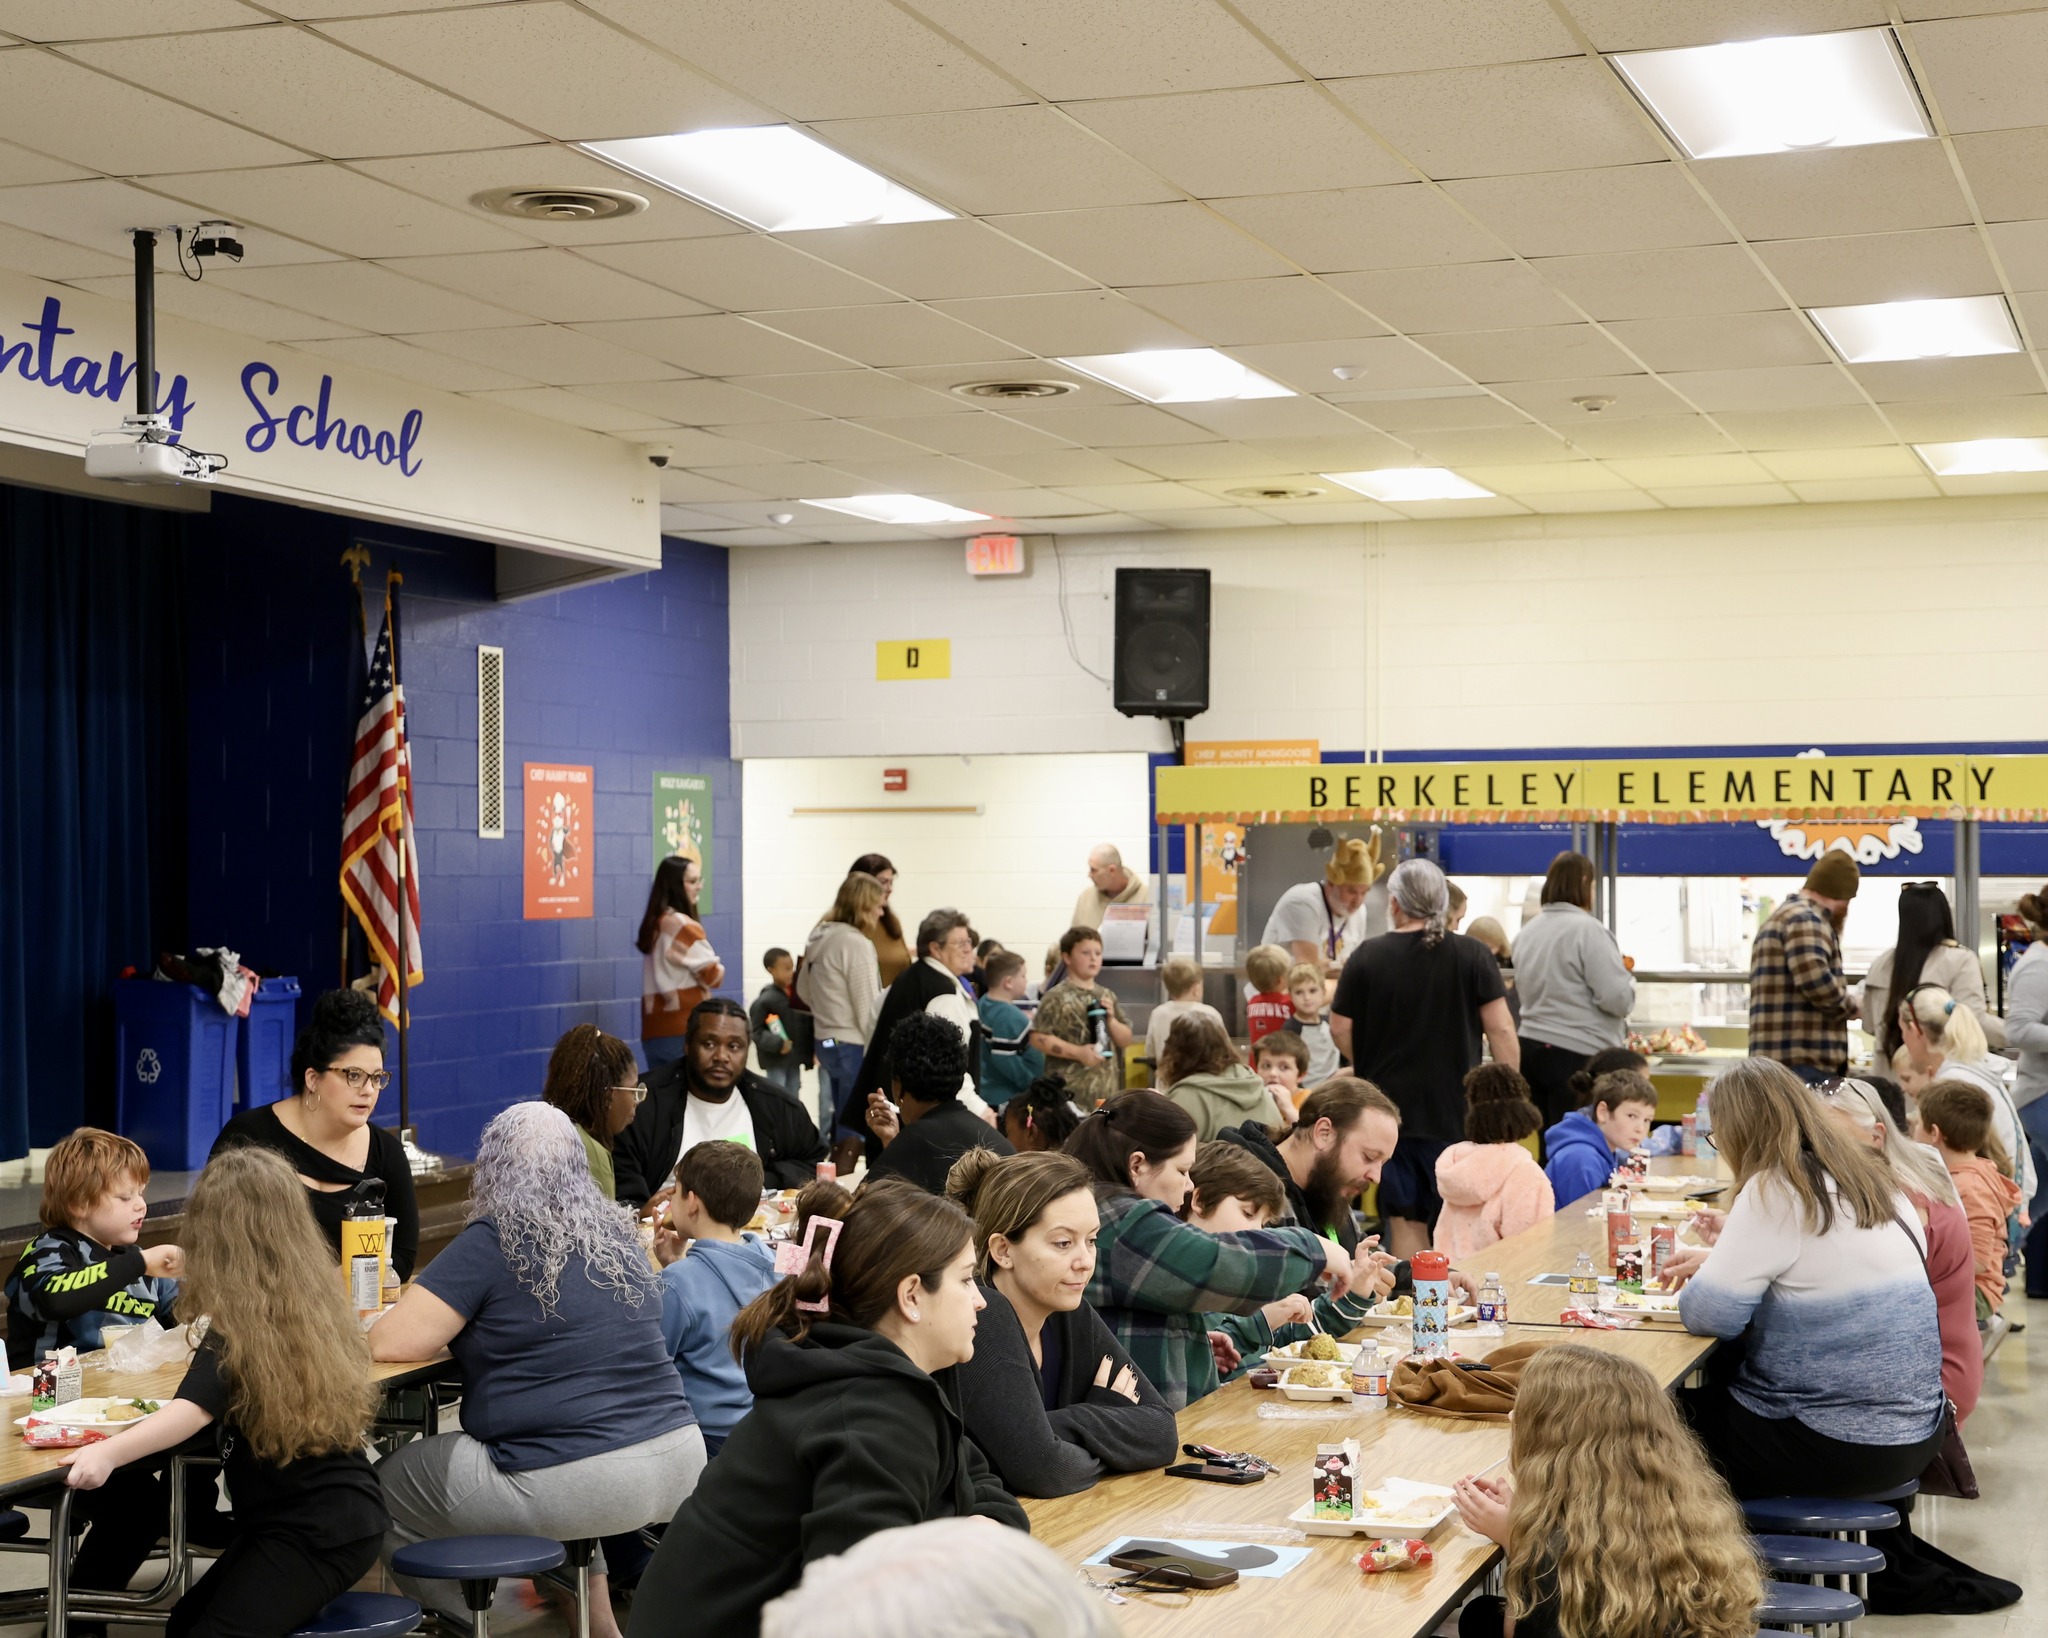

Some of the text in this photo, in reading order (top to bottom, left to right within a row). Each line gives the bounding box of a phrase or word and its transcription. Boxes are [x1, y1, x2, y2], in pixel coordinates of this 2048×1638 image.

[241, 361, 423, 477] School
[975, 537, 1016, 572] EXIT
[907, 647, 919, 669] D
[1310, 767, 1995, 808] BERKELEY ELEMENTARY
[44, 1261, 109, 1294] THOR
